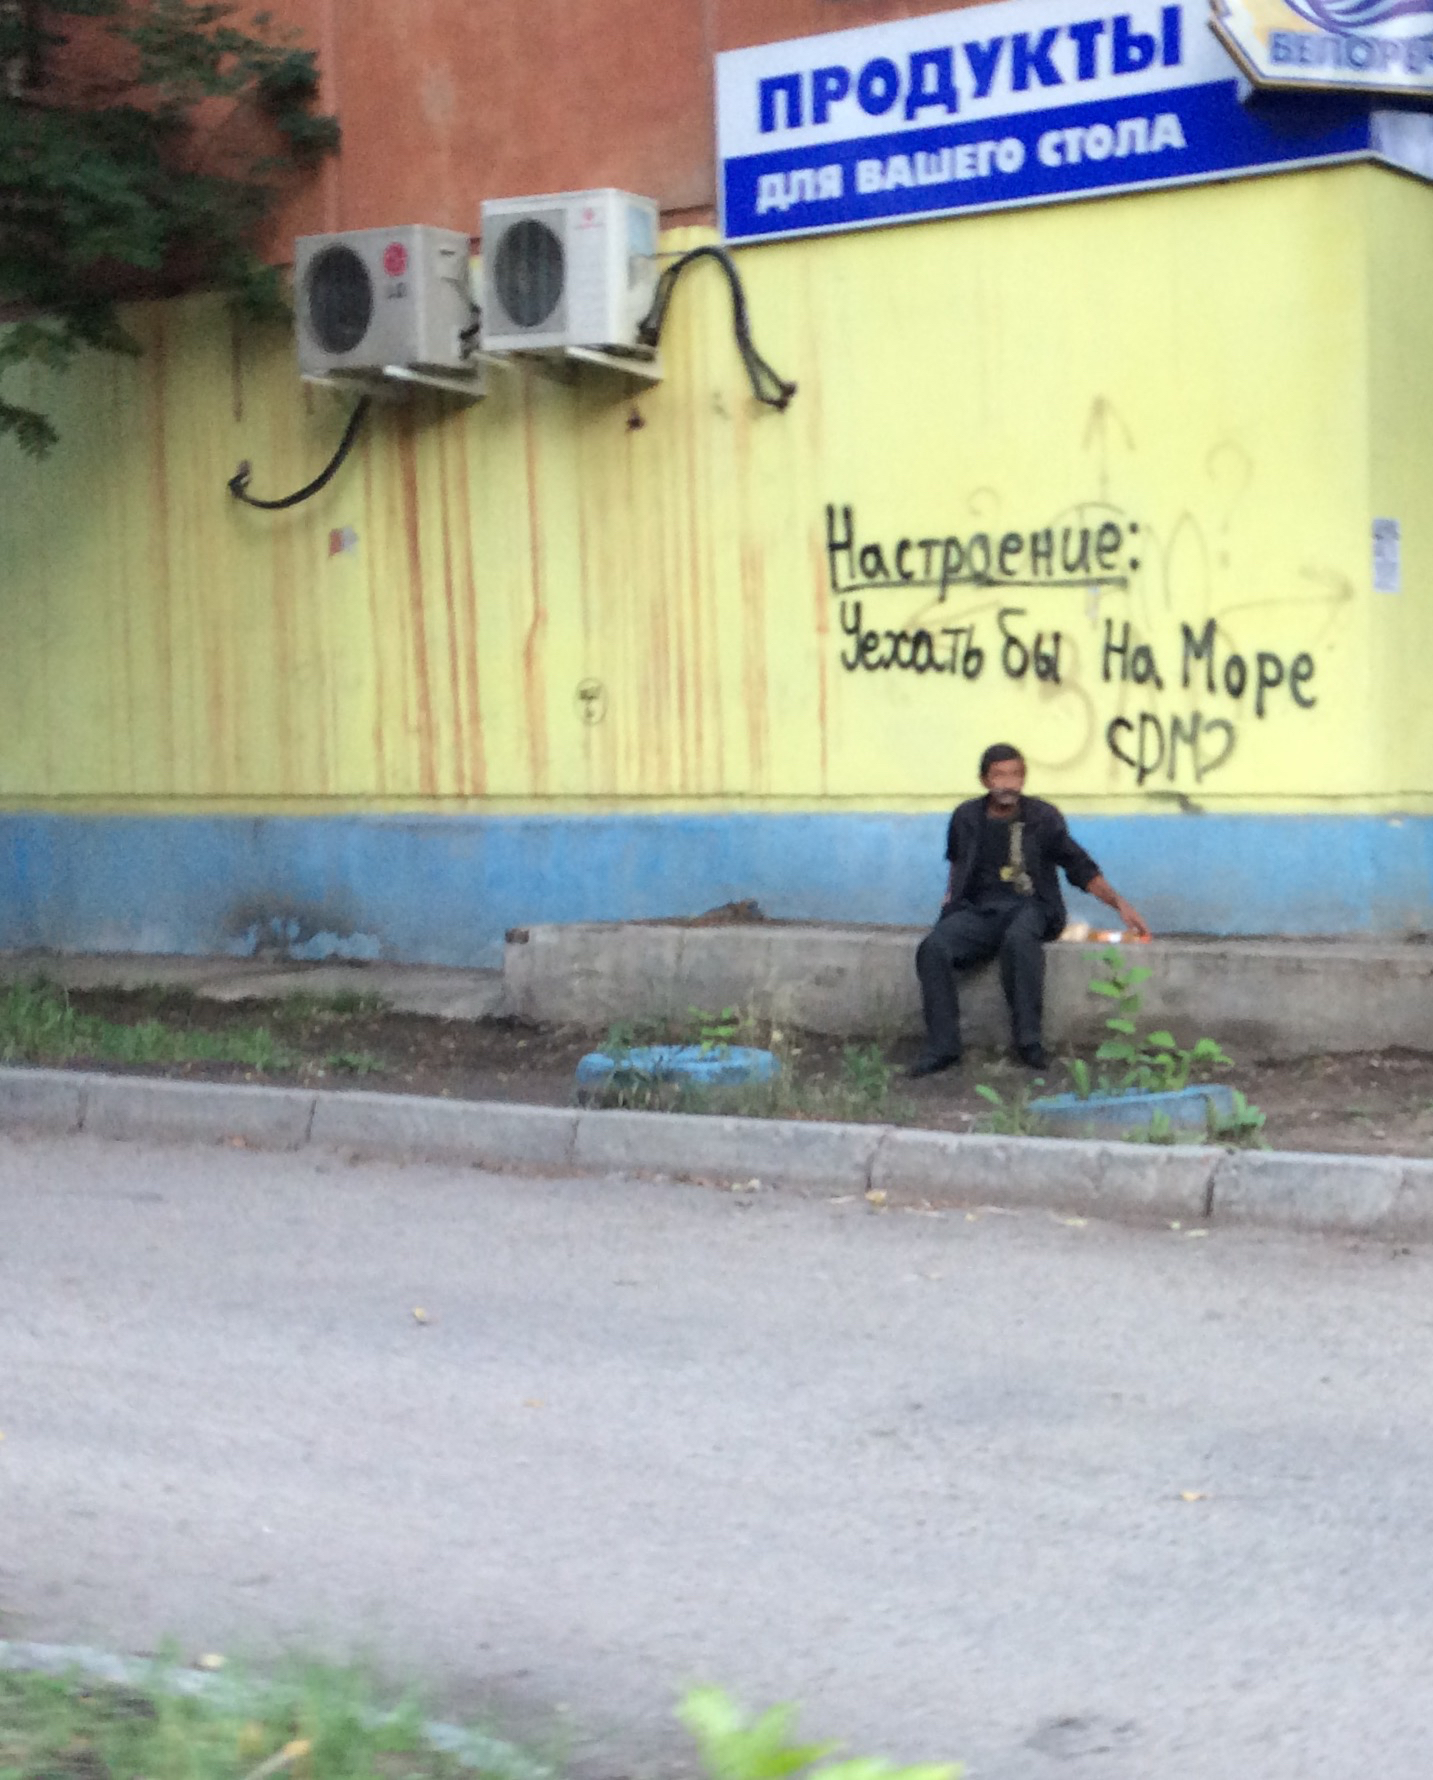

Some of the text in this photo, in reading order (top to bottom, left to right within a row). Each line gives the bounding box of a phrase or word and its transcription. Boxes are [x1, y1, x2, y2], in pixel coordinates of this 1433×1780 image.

[758, 4, 1182, 134] ПРОДУКТЫ
[756, 113, 1187, 215] ДЛЯ ВАШЕГО СТОЛА
[826, 503, 1140, 602] Настроение:
[840, 600, 1318, 719] Уехать бы На Море
